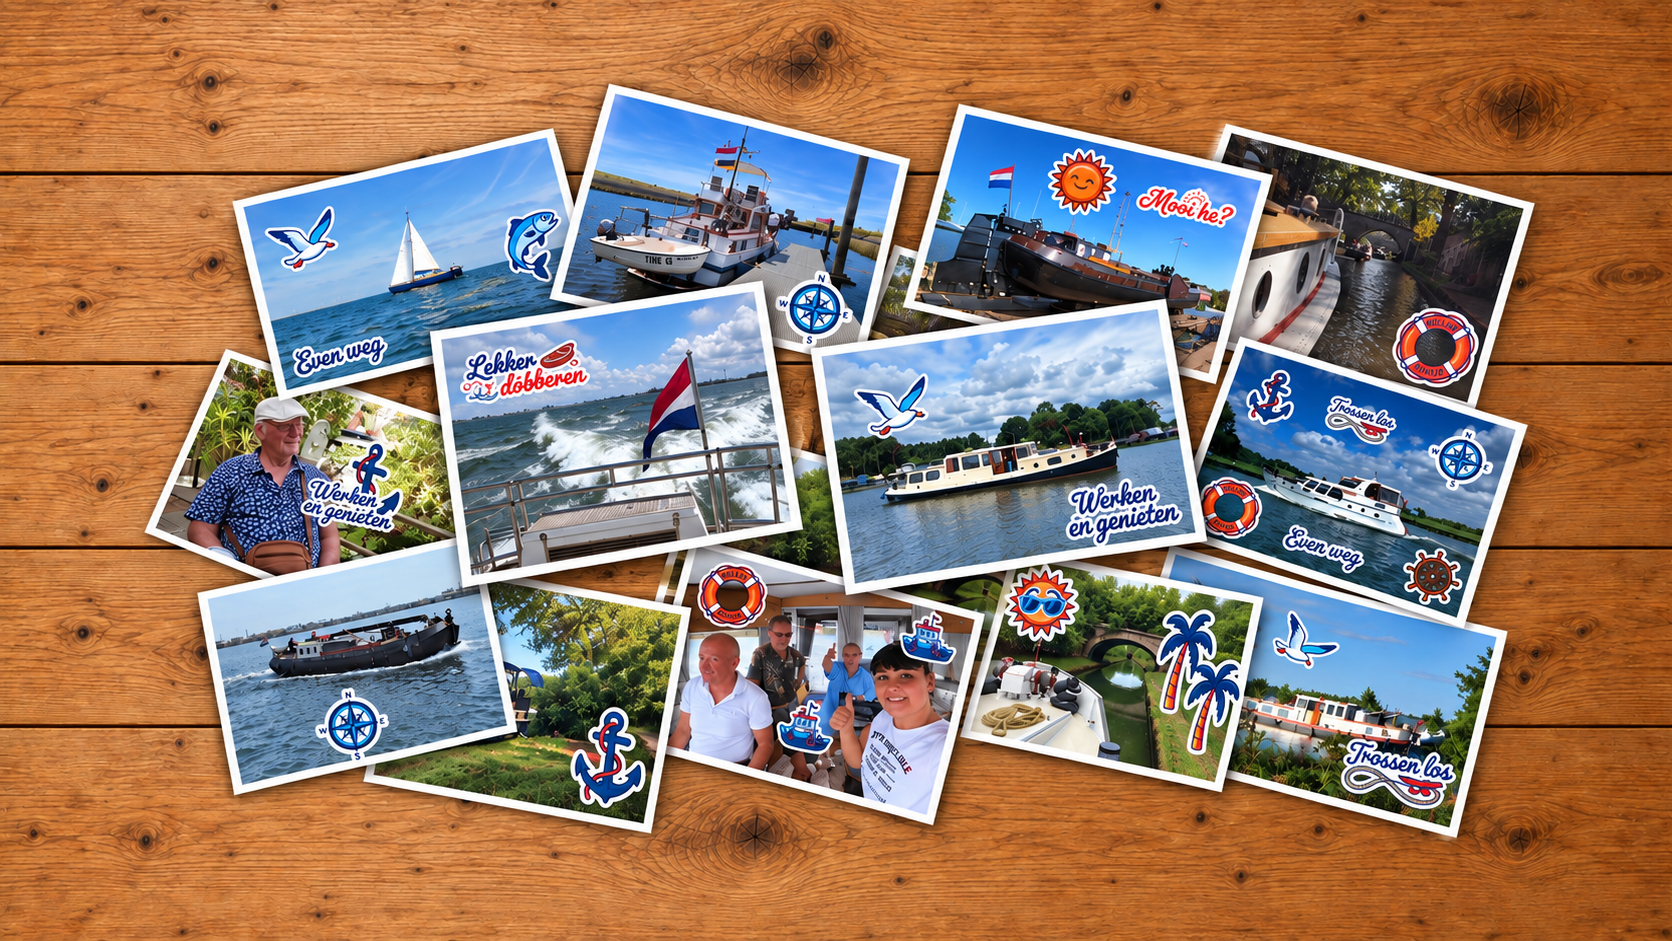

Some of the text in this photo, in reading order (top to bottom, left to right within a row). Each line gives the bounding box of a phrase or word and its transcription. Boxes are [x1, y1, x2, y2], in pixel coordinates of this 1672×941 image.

[1139, 189, 1234, 225] Mooi he?
[817, 274, 826, 283] N
[779, 299, 789, 308] W
[842, 311, 849, 320] E
[806, 335, 813, 345] S
[295, 339, 385, 375] Even weg
[466, 349, 537, 381] Lekker
[1464, 431, 1473, 440] N
[1431, 447, 1440, 455] W
[1483, 464, 1490, 472] E
[1449, 480, 1456, 488] S
[310, 480, 378, 508] Werken
[1071, 481, 1157, 515] Werken
[303, 502, 323, 515] en
[1069, 503, 1180, 544] en genieten
[1285, 527, 1362, 572] Even weg
[345, 691, 352, 699] N
[379, 717, 386, 725] E
[318, 727, 328, 735] W
[354, 752, 361, 761] S
[1346, 741, 1453, 781] Trossen los
